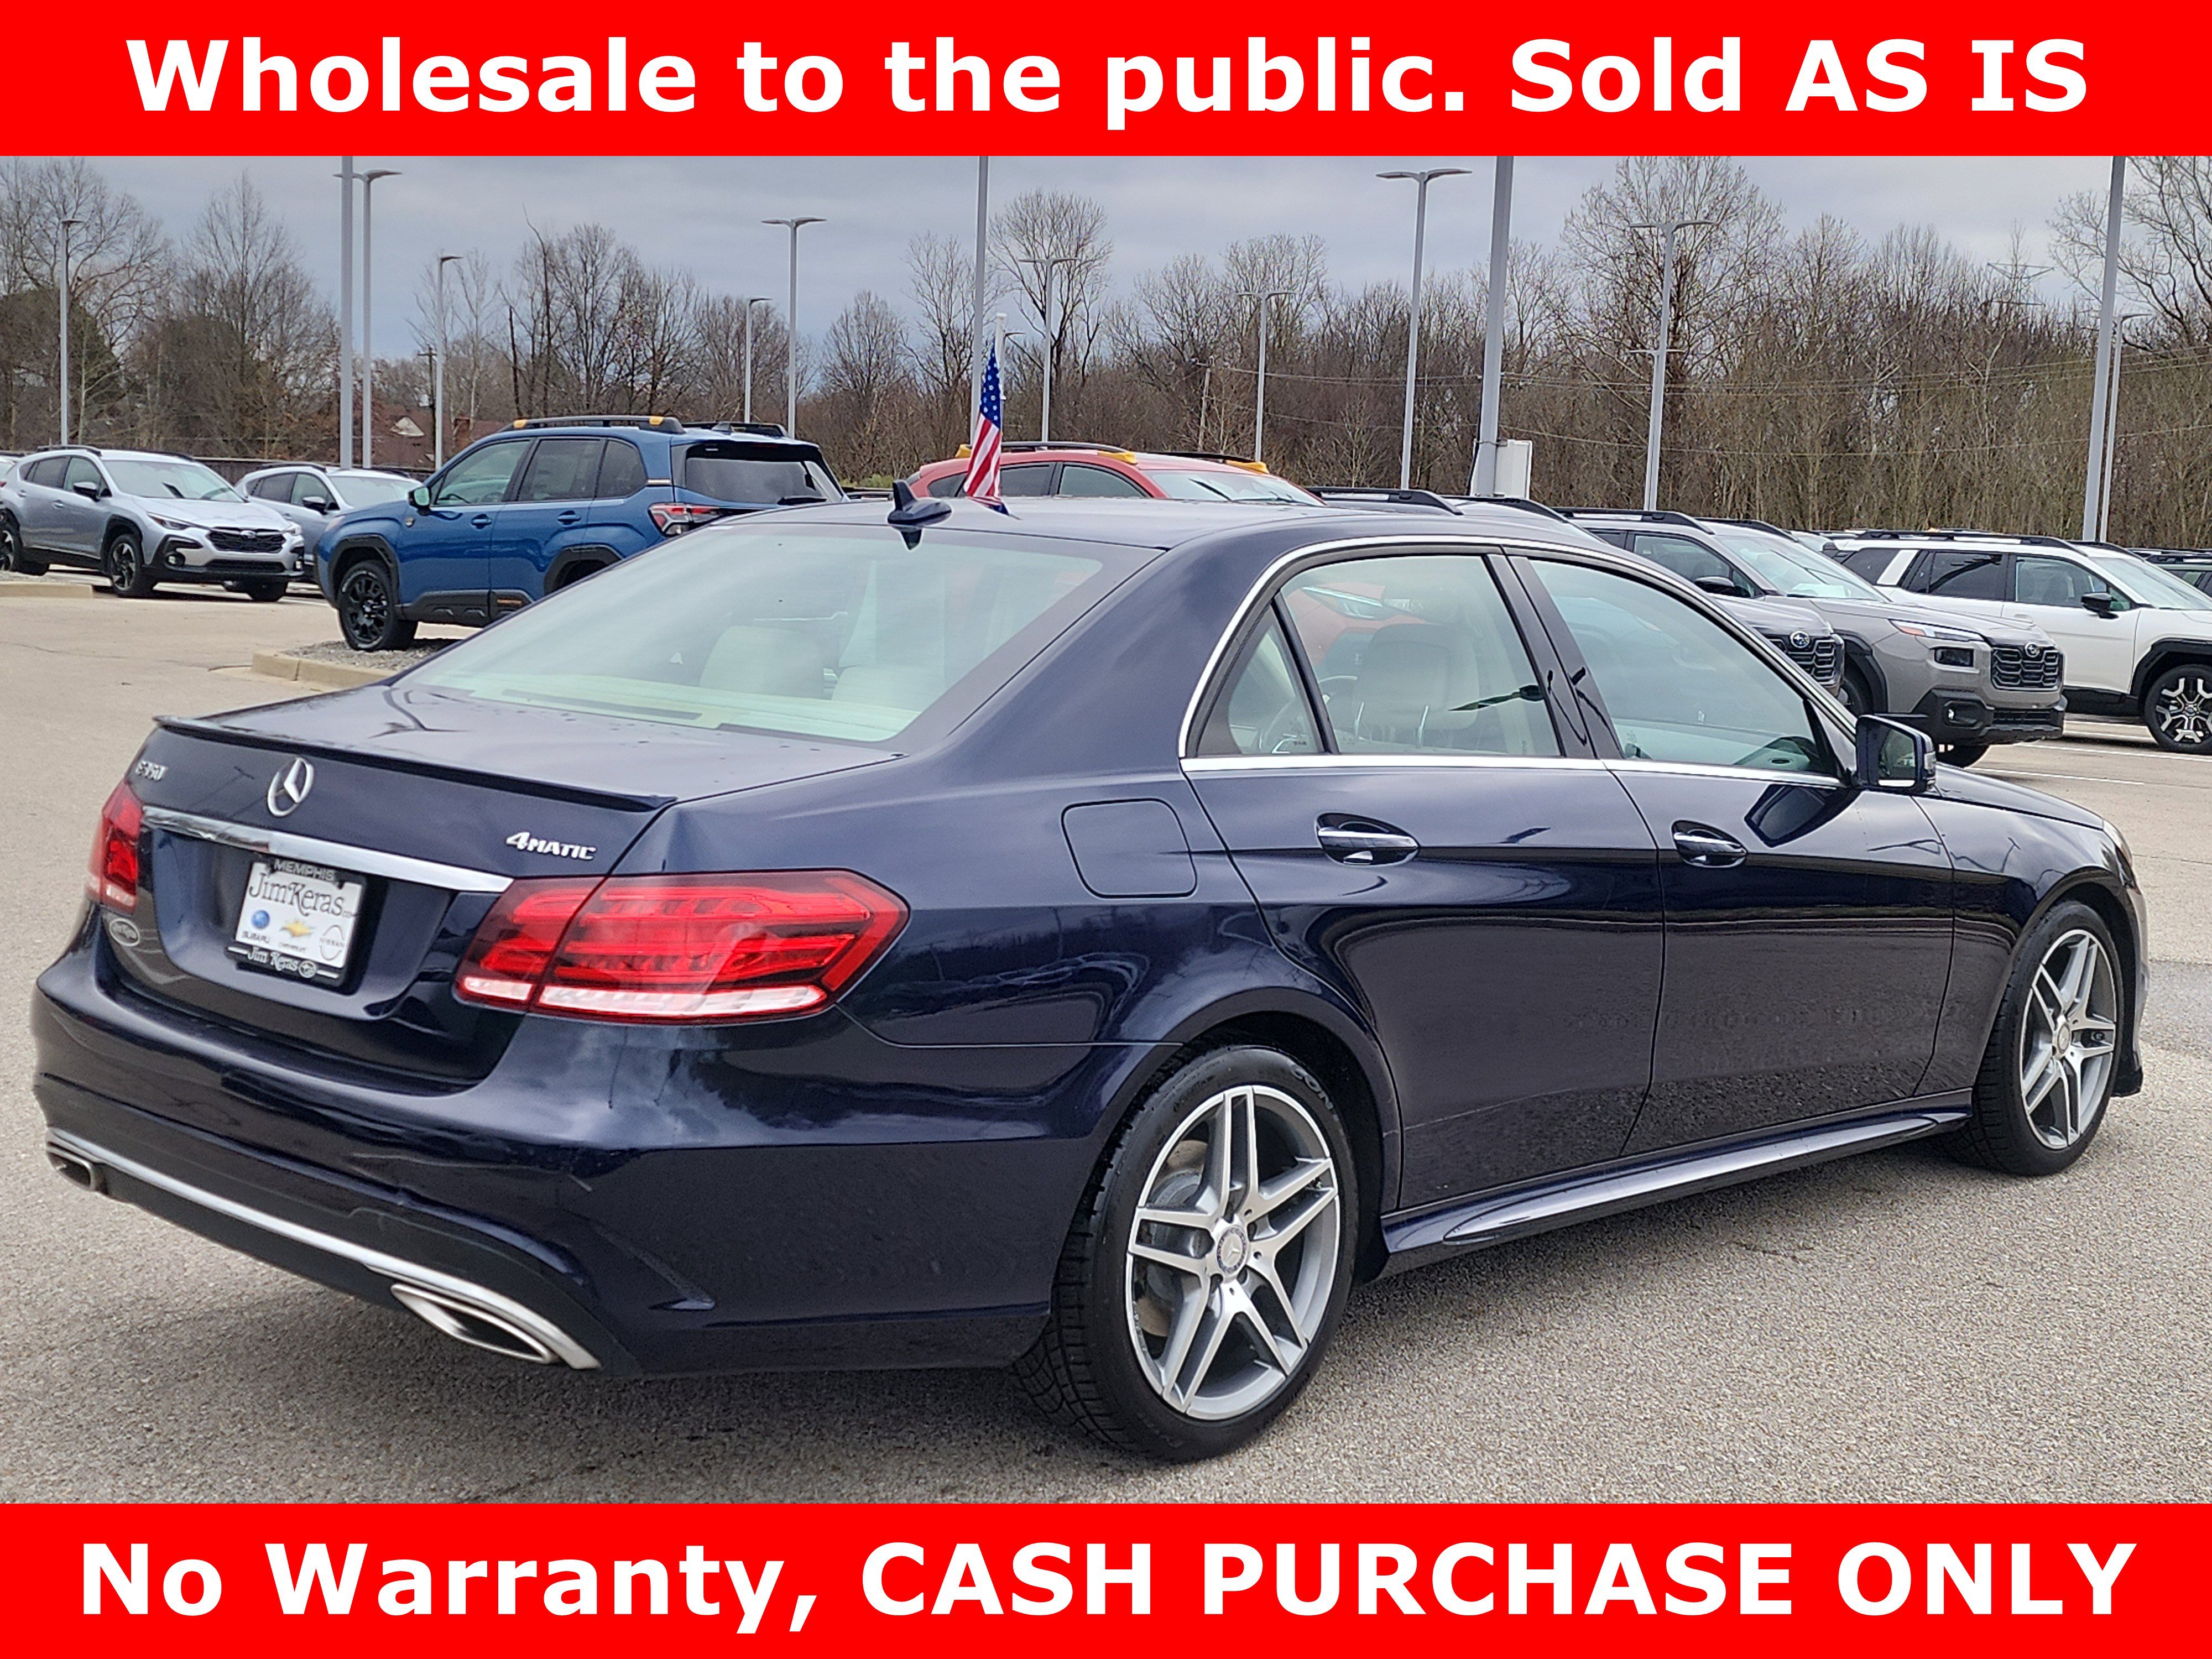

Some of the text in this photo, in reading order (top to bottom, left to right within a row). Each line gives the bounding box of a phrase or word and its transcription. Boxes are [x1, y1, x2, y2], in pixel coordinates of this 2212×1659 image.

[505, 831, 597, 860] 4MATIC
[274, 859, 336, 883] MEMPHIS
[247, 946, 269, 963] Jim
[270, 951, 299, 972] Keras
